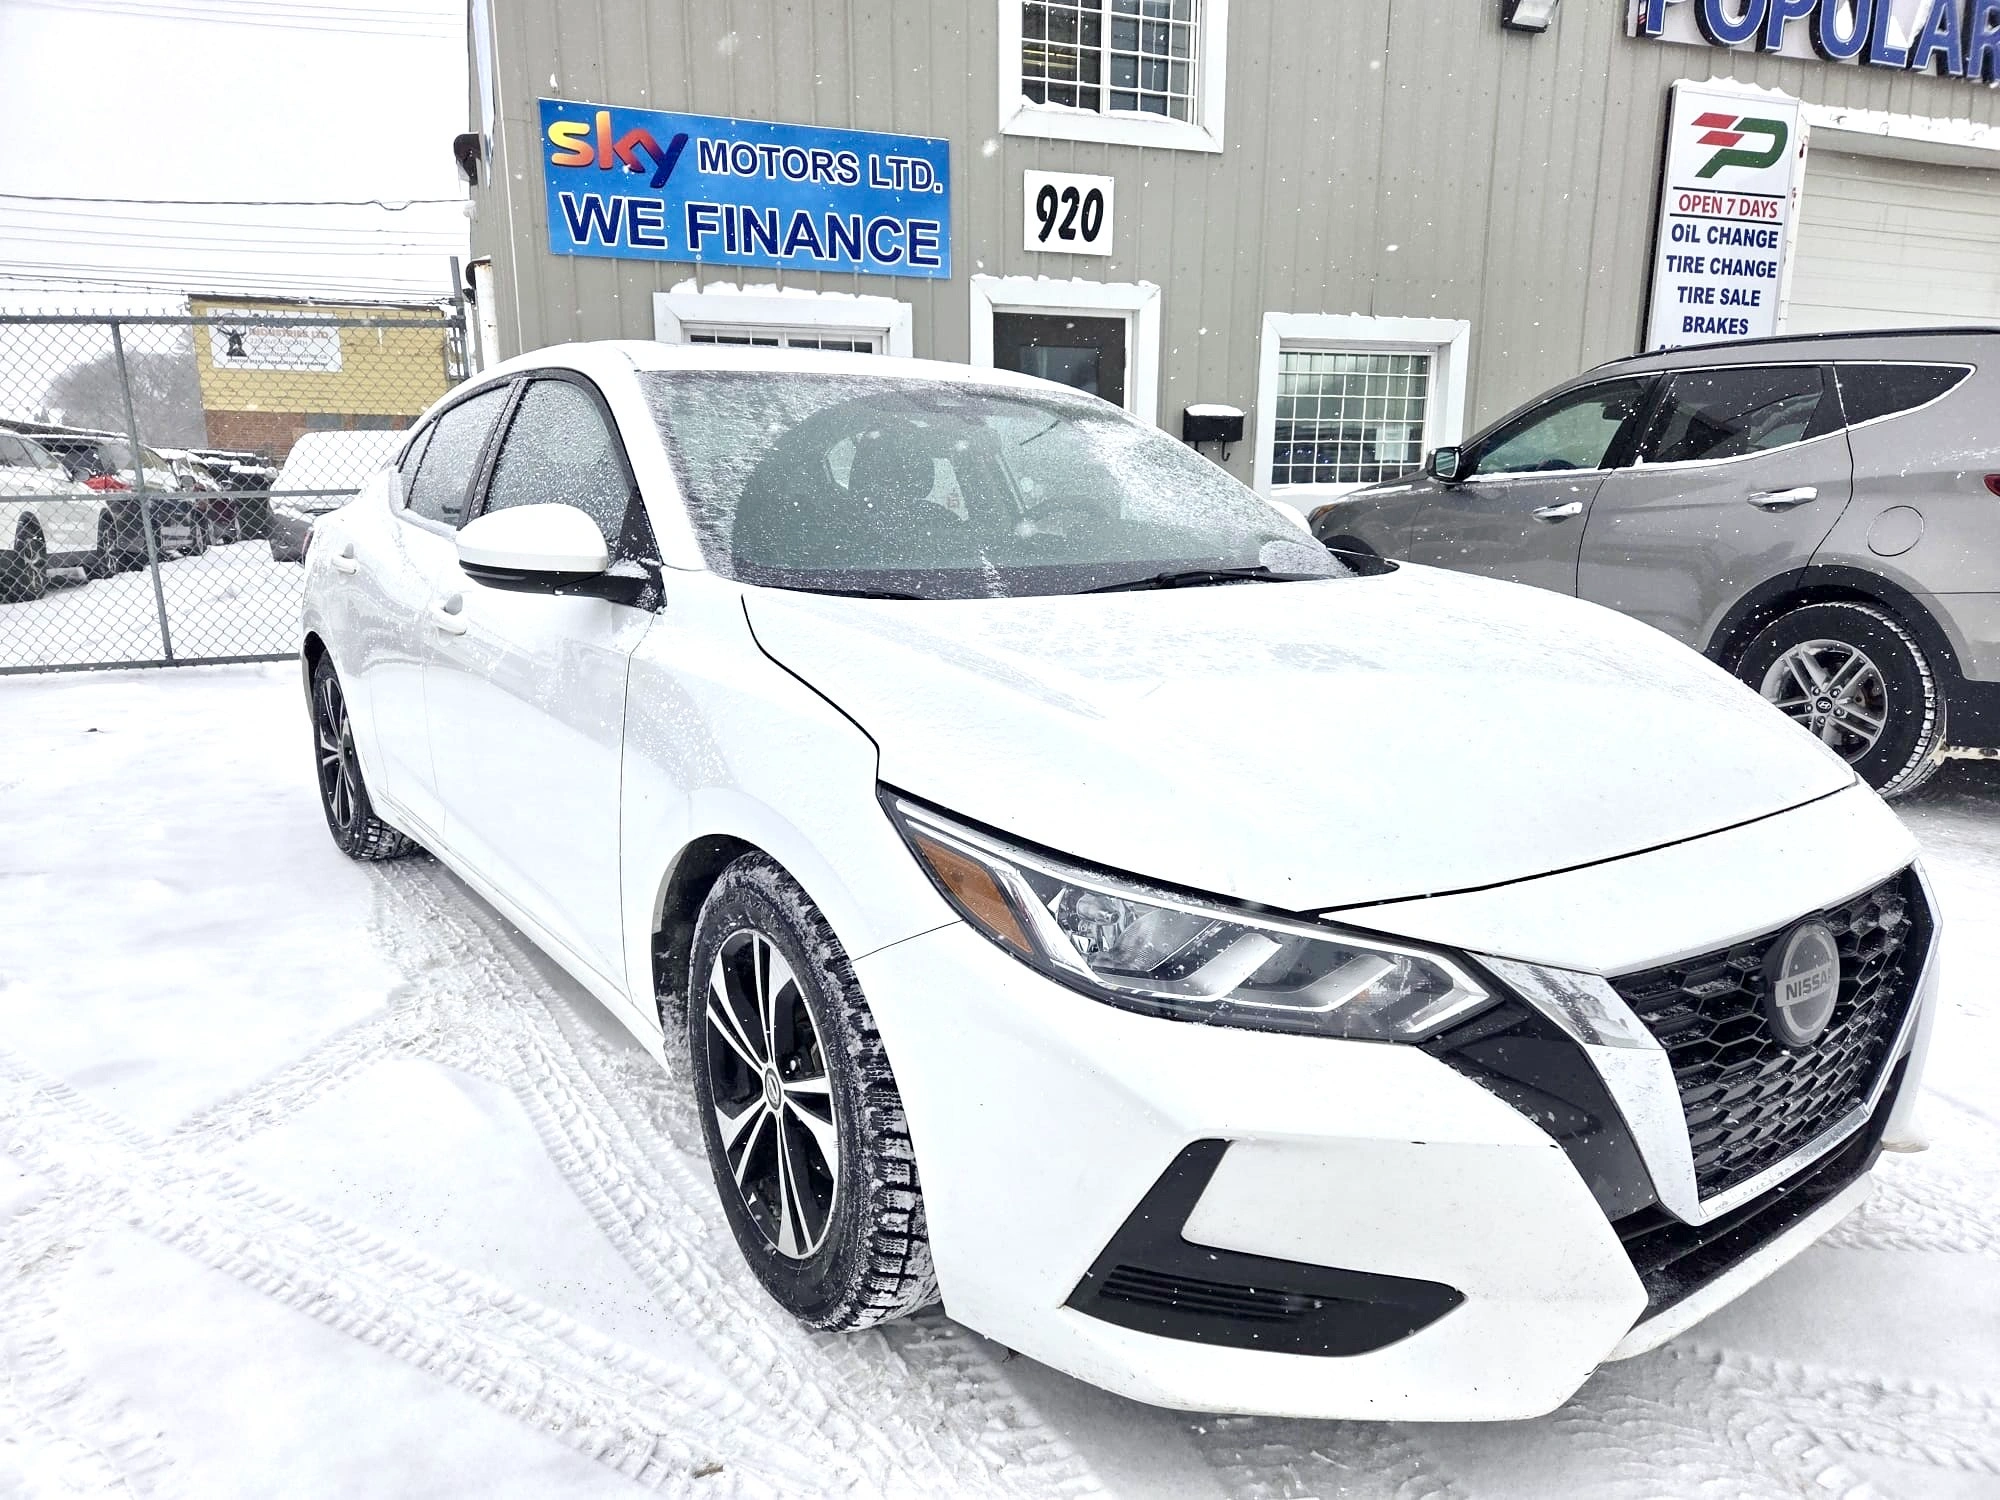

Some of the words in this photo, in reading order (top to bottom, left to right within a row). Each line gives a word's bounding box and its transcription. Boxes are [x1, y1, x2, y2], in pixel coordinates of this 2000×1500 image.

[547, 110, 688, 188] sky
[698, 137, 859, 185] MOTORS
[869, 155, 943, 193] LTD.
[1036, 184, 1104, 243] 920
[1679, 194, 1722, 214] OPEN
[1727, 198, 1736, 215] 7
[1739, 198, 1778, 218] DAYS
[559, 192, 667, 248] WE
[685, 201, 940, 268] FINANCE
[1707, 226, 1778, 249] CHANGE
[1666, 255, 1705, 274] TIRE
[1710, 257, 1777, 278] CHANGE
[1677, 286, 1715, 305] TIRE
[1720, 288, 1761, 307] SALE
[1682, 316, 1749, 335] BRAKES
